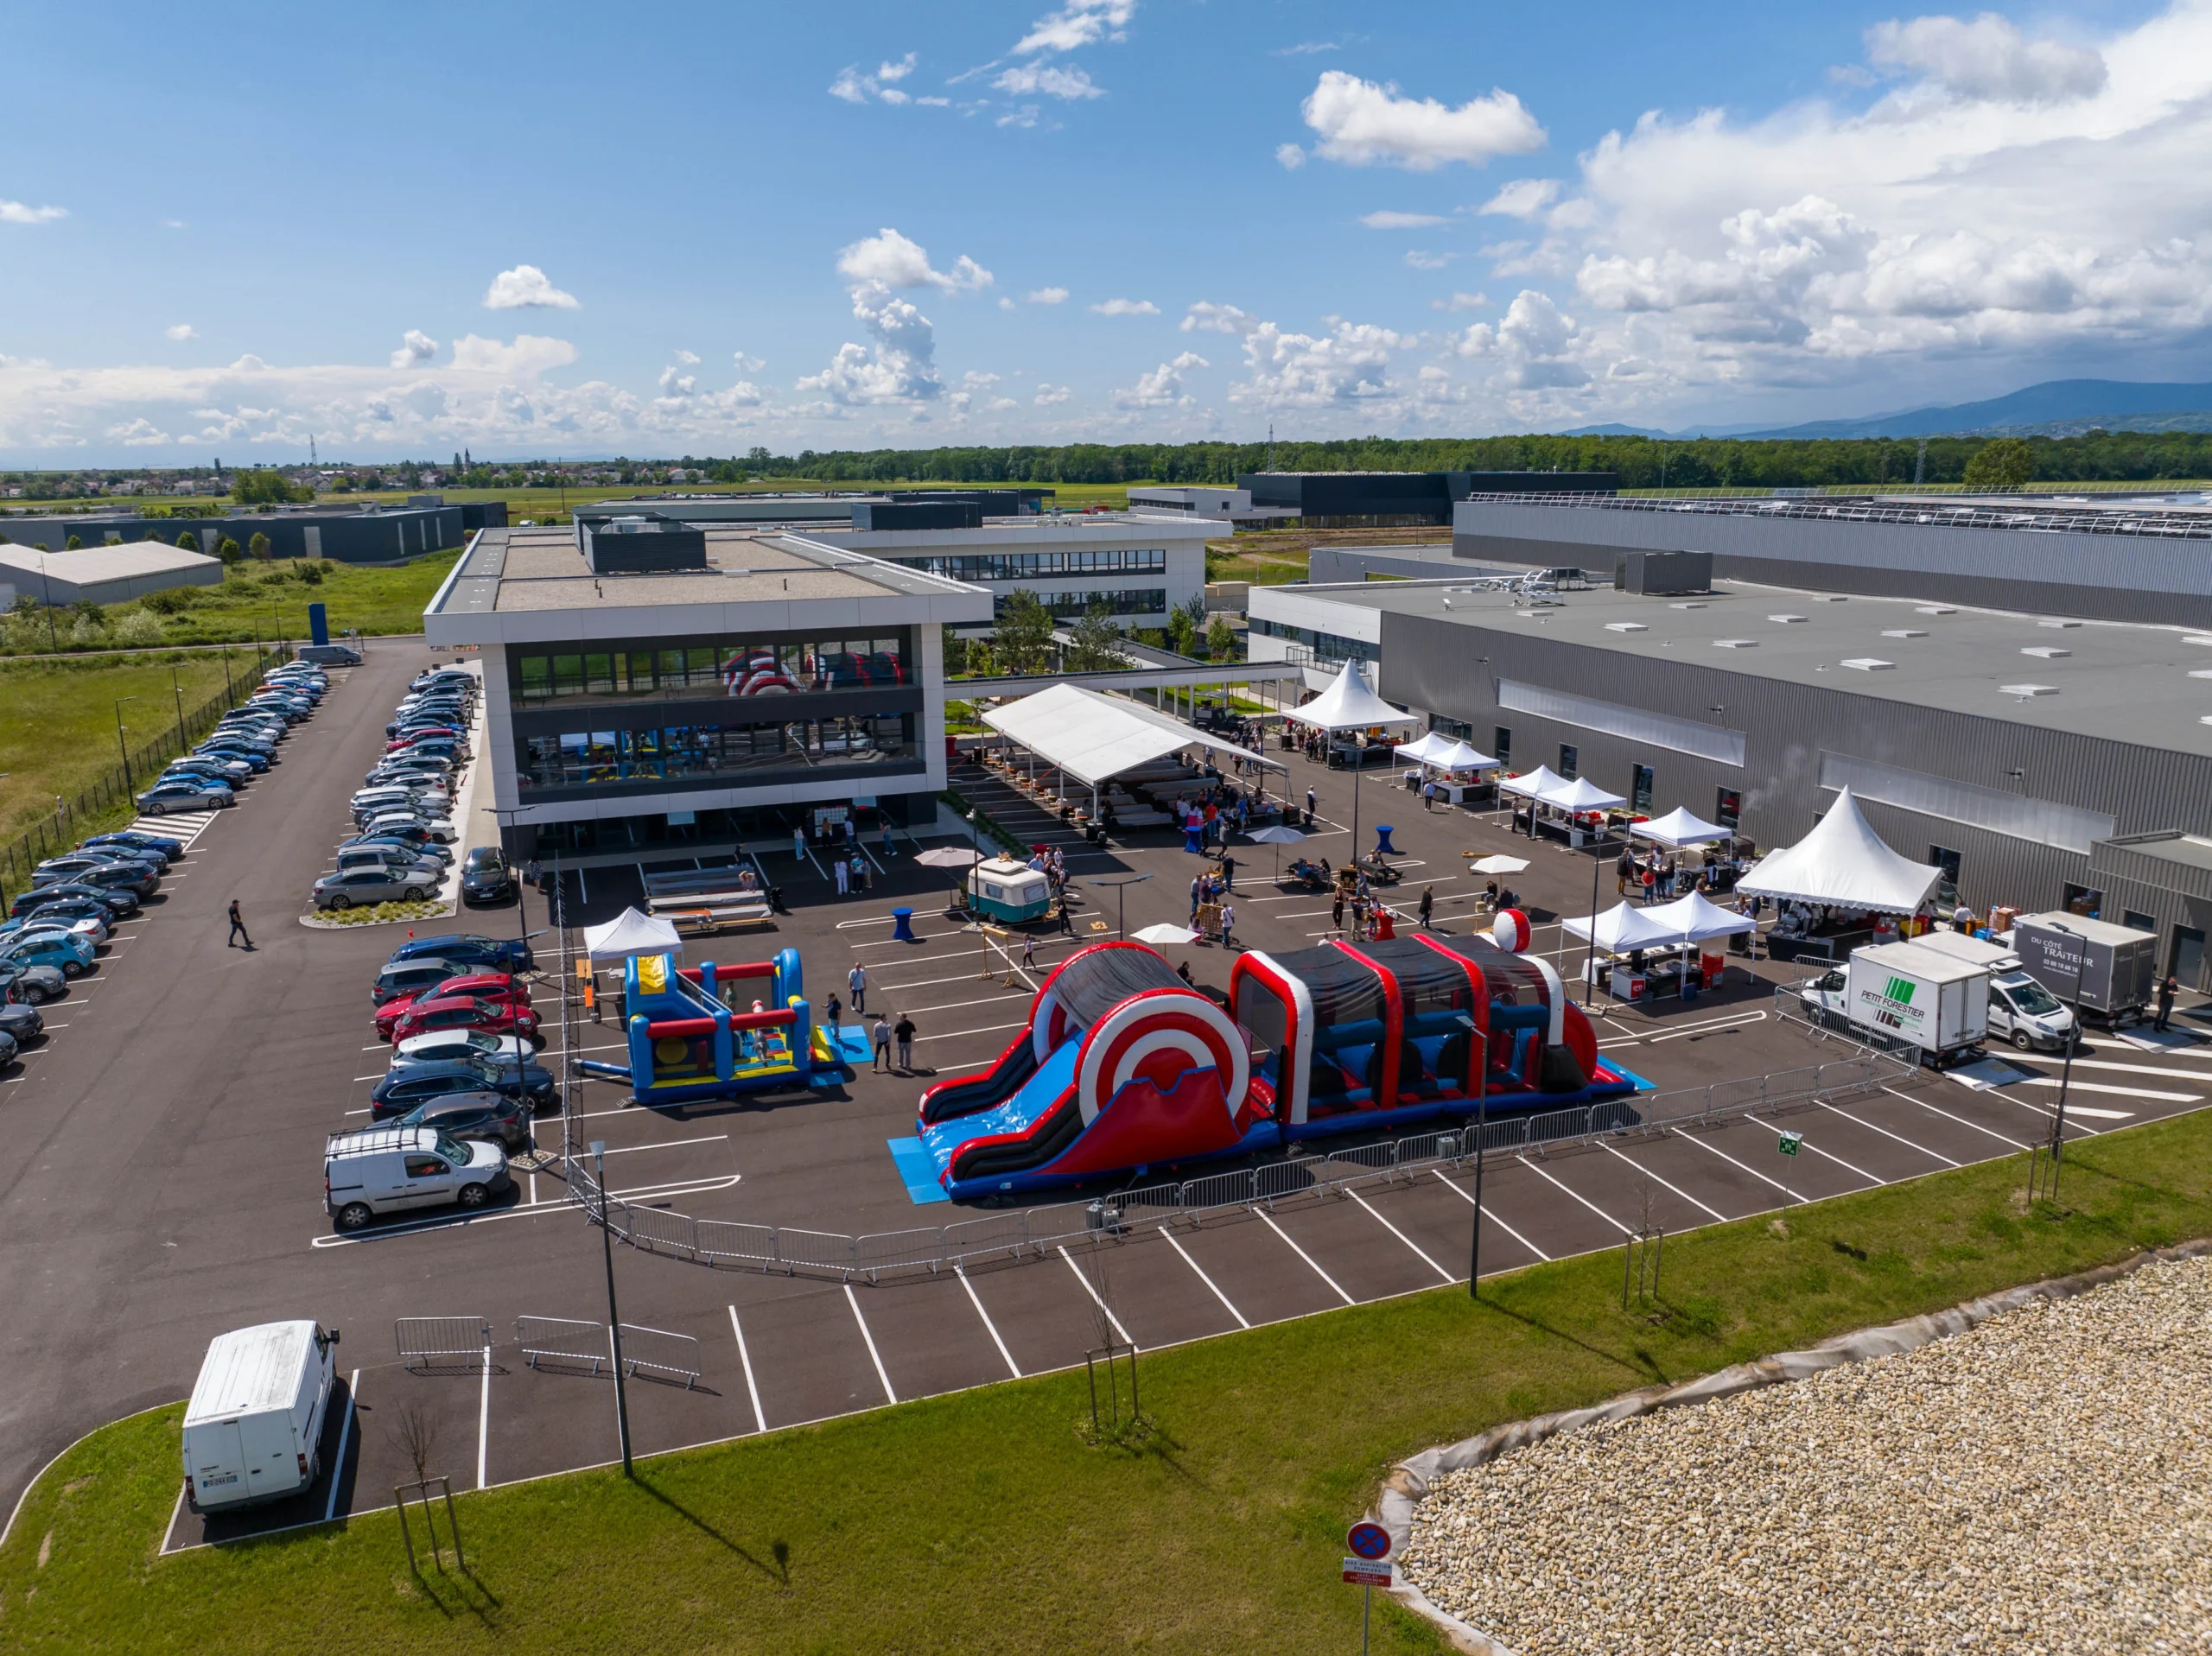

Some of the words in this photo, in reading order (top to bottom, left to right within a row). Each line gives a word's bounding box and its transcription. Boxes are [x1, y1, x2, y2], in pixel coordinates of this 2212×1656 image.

[2043, 940, 2063, 950] CÔTÉ
[1861, 990, 1883, 1003] PETIT
[1883, 998, 1924, 1018] FORESTIER
